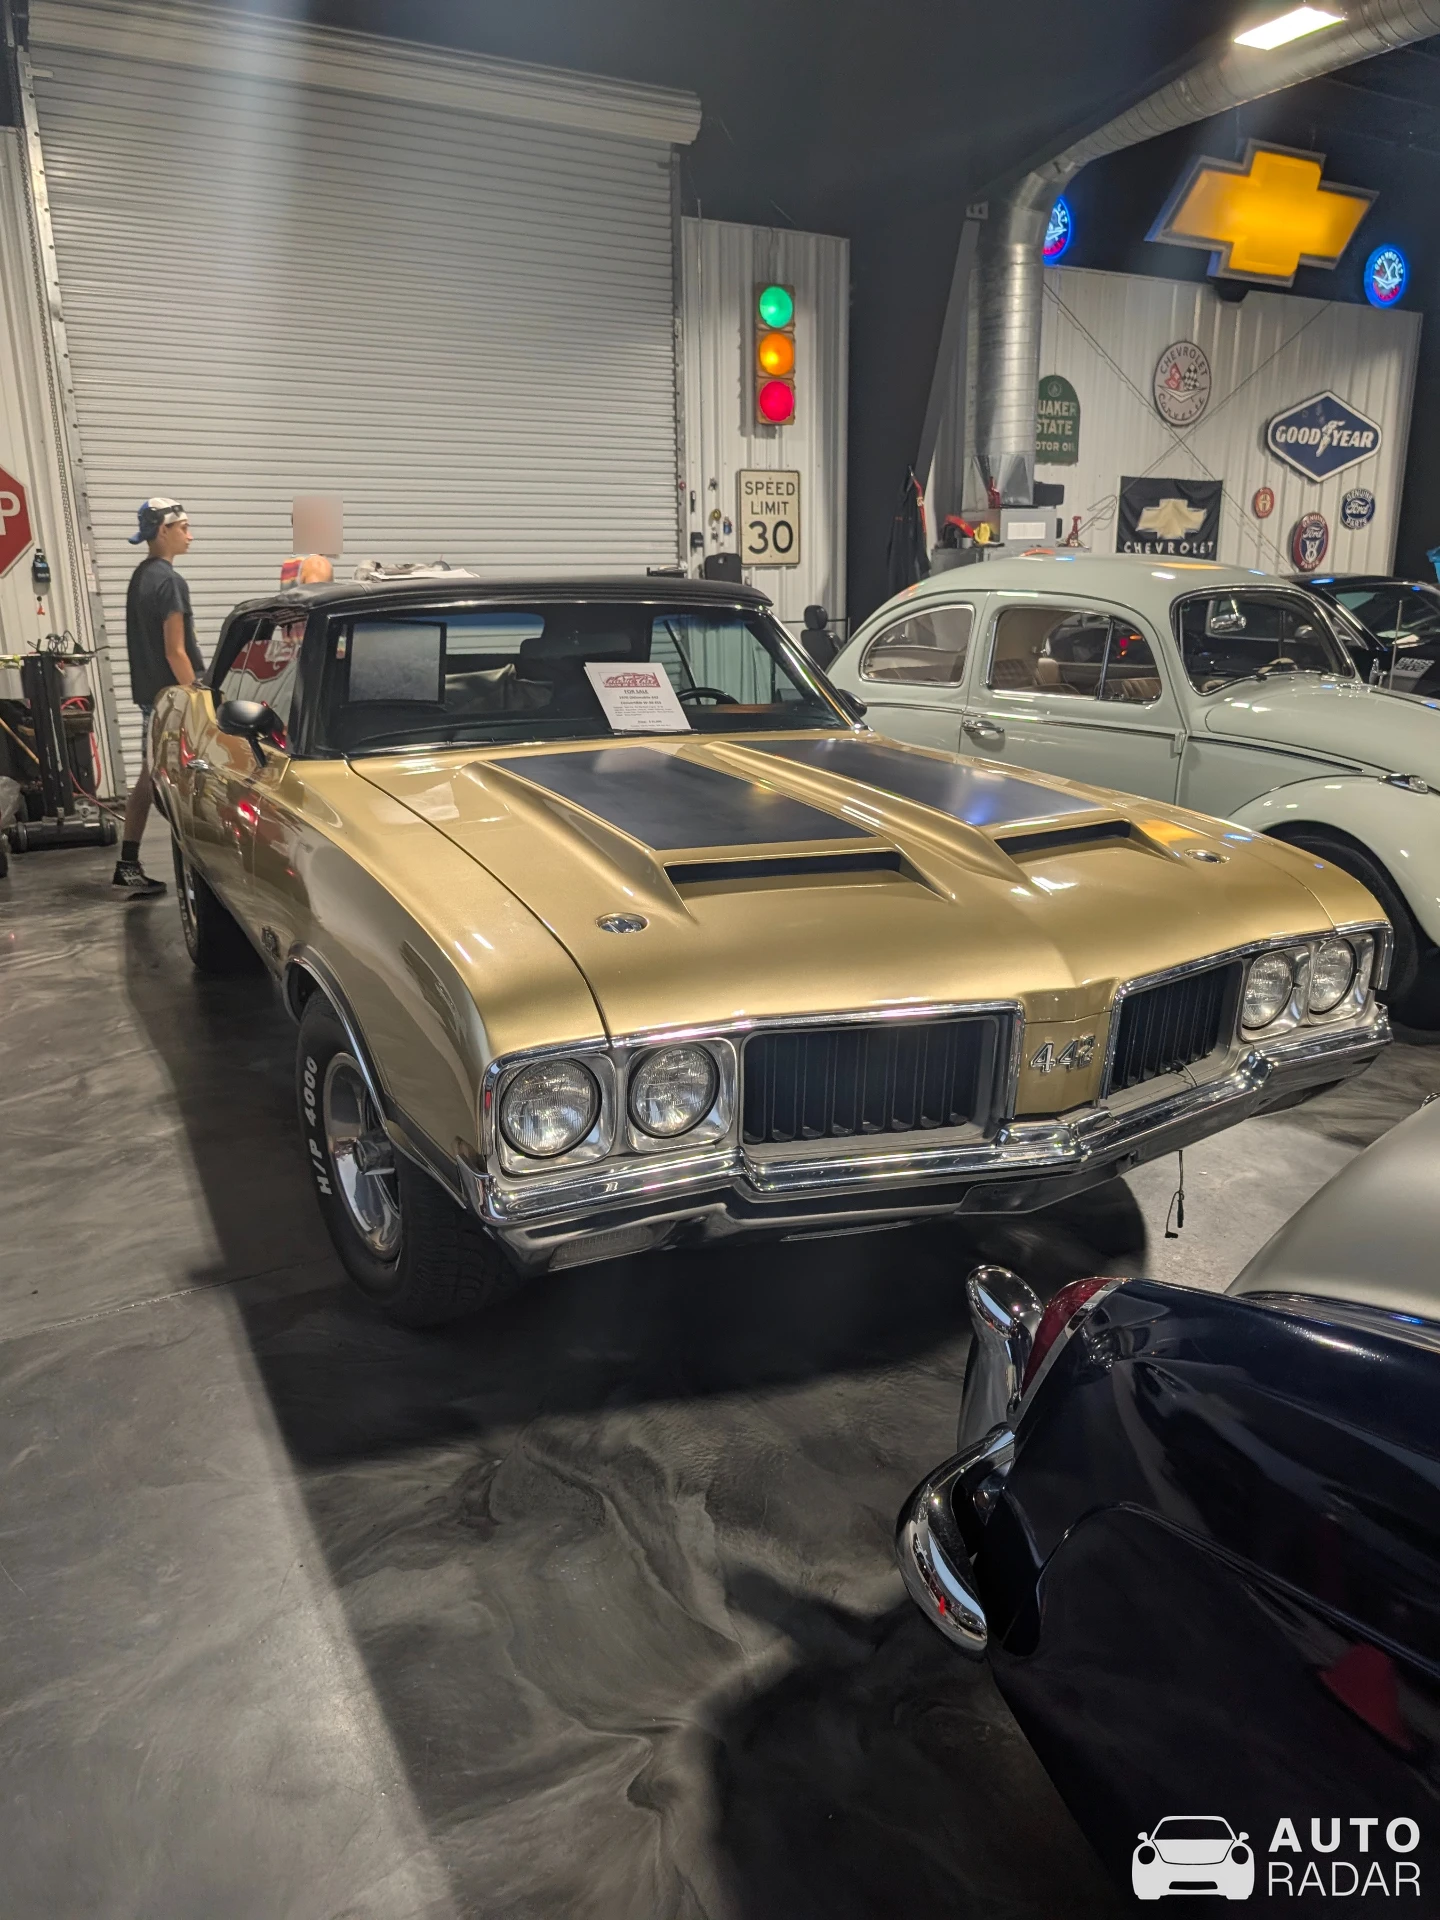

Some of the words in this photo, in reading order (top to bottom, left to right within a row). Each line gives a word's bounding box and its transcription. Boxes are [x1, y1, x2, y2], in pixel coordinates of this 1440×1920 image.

[1160, 346, 1208, 376] CHEVROLET
[1037, 400, 1078, 416] UAKER
[1036, 441, 1060, 452] OTOR
[745, 481, 796, 496] SPEED
[751, 501, 790, 516] LIMIT
[1346, 500, 1370, 514] Ford
[748, 520, 794, 555] 30
[1302, 526, 1324, 538] Ford
[1123, 541, 1214, 555] CHEVROLET
[303, 1055, 318, 1127] 4000
[309, 1138, 333, 1195] H/P
